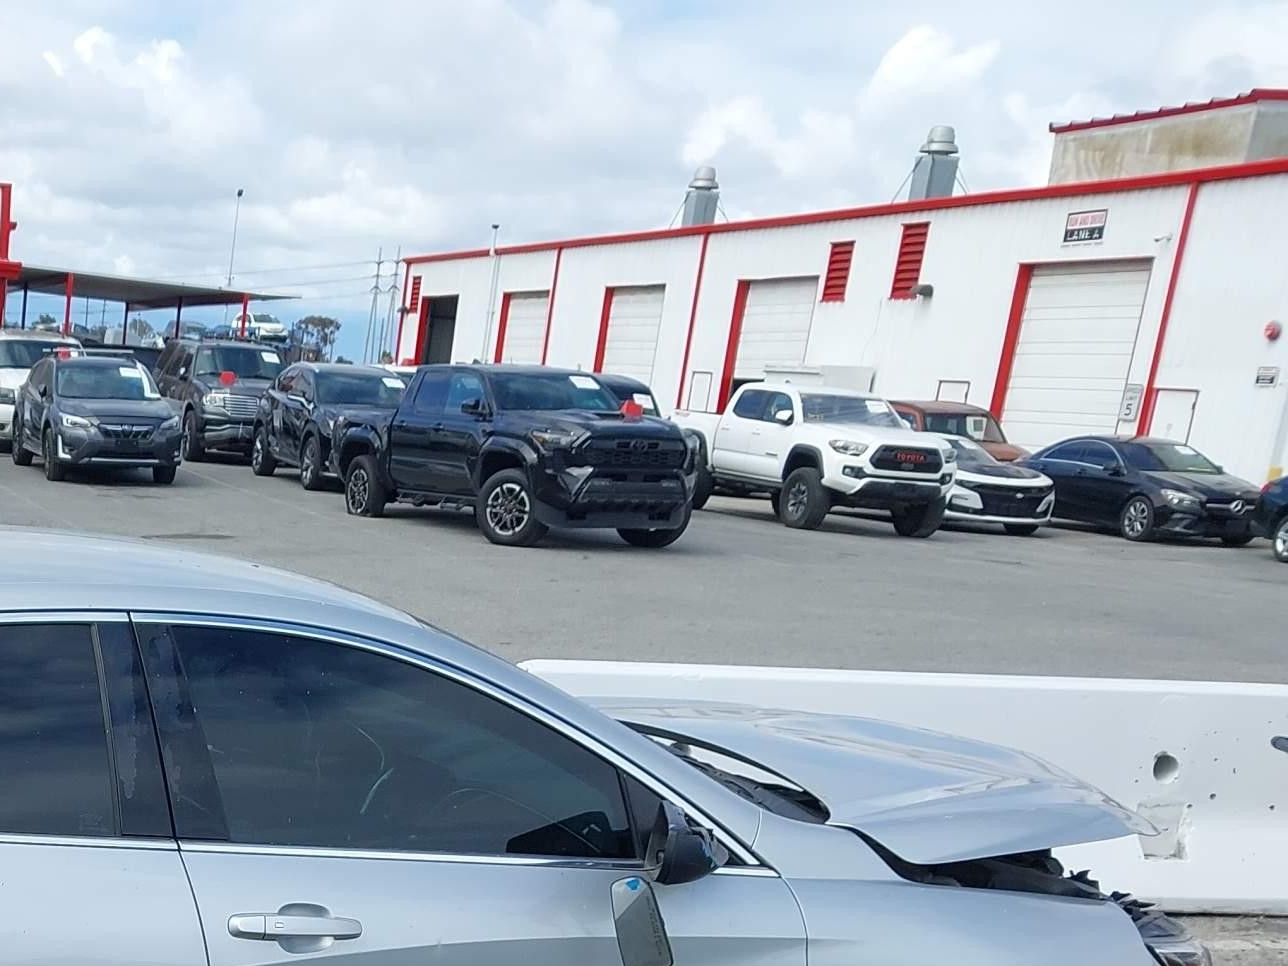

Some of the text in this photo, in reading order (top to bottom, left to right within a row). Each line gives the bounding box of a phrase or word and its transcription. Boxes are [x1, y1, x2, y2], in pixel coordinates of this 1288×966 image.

[1067, 229, 1091, 240] LANE
[1124, 403, 1133, 416] 5
[896, 452, 925, 462] TOYOTA
